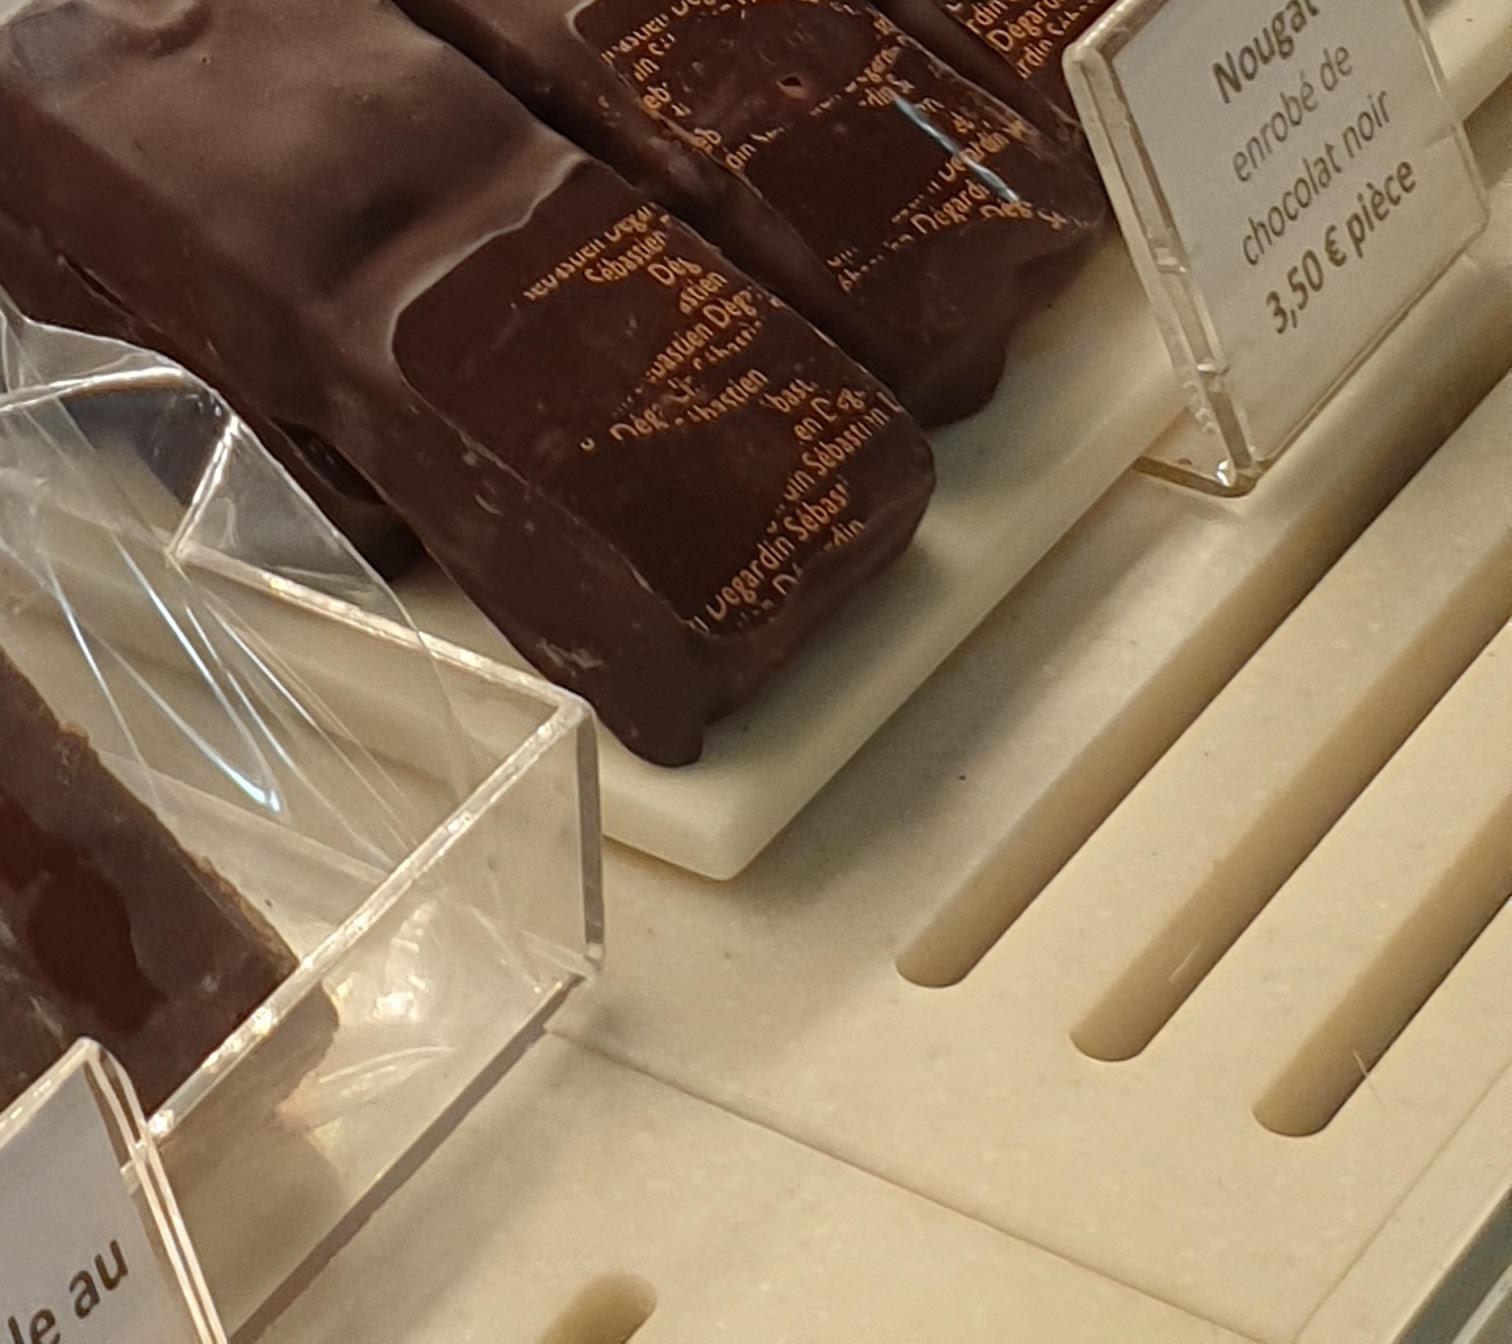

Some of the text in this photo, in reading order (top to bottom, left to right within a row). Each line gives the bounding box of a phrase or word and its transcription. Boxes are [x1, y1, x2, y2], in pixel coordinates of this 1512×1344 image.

[1233, 45, 1352, 182] enrobé de
[1242, 90, 1389, 266] chocolat noir
[1265, 161, 1416, 334] 3,50 € pièce
[68, 1239, 129, 1319] au
